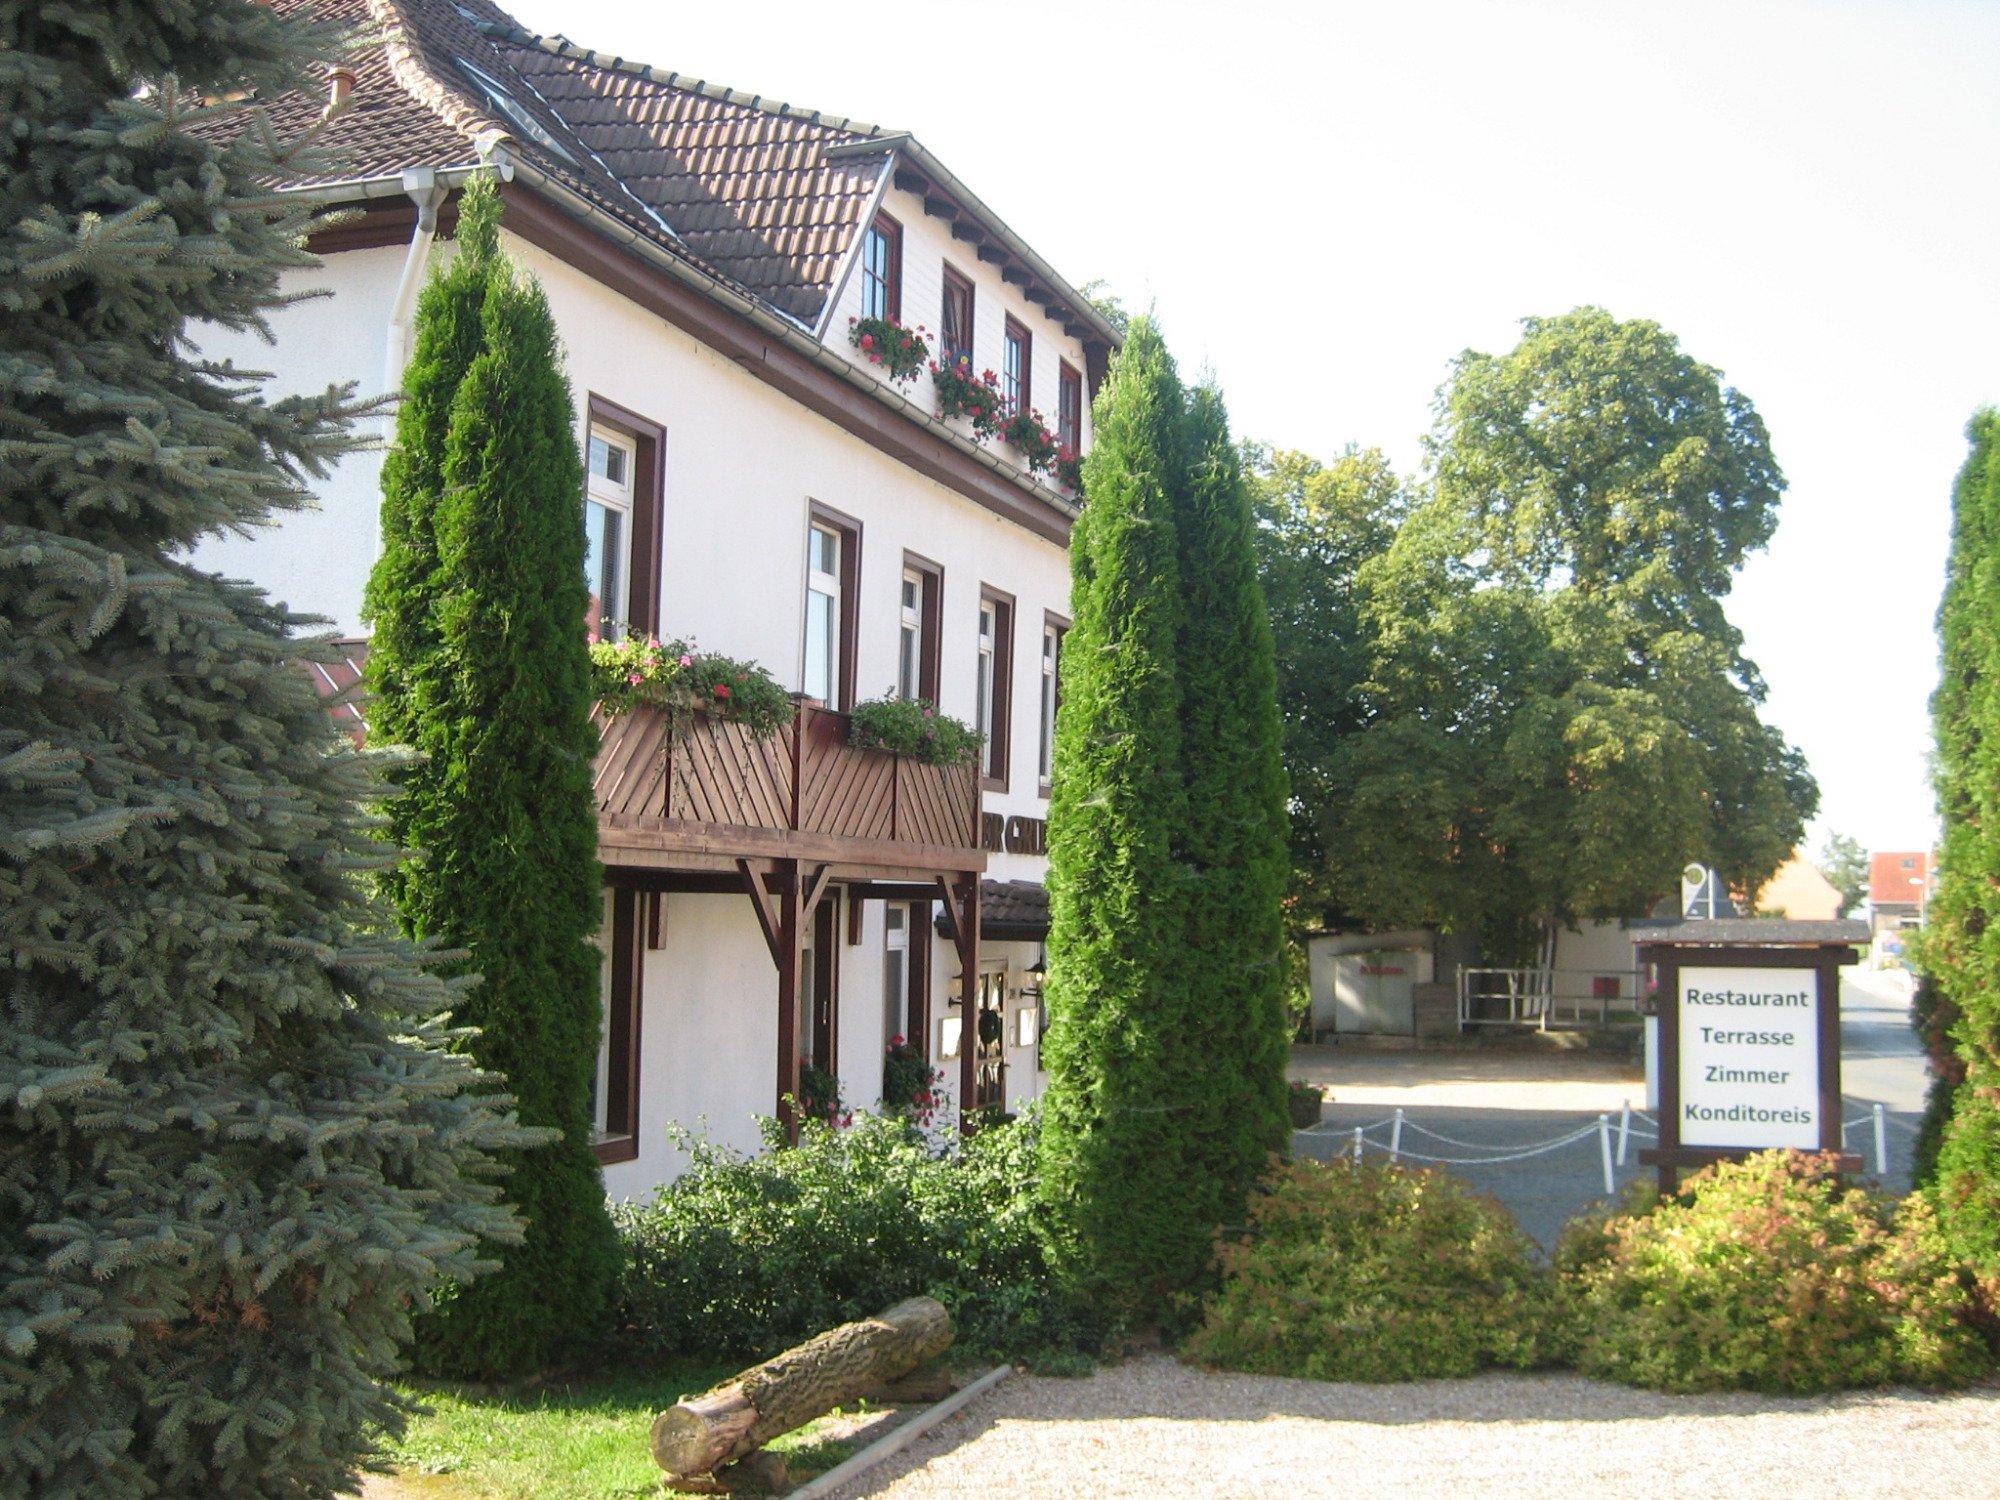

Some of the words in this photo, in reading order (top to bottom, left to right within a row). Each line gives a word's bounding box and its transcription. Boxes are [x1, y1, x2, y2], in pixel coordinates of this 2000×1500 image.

[1686, 988, 1809, 1007] Restaurant
[1700, 1027, 1795, 1046] Terrasse
[1705, 1065, 1790, 1085] Zimmer
[1685, 1104, 1812, 1124] Konditoreis
